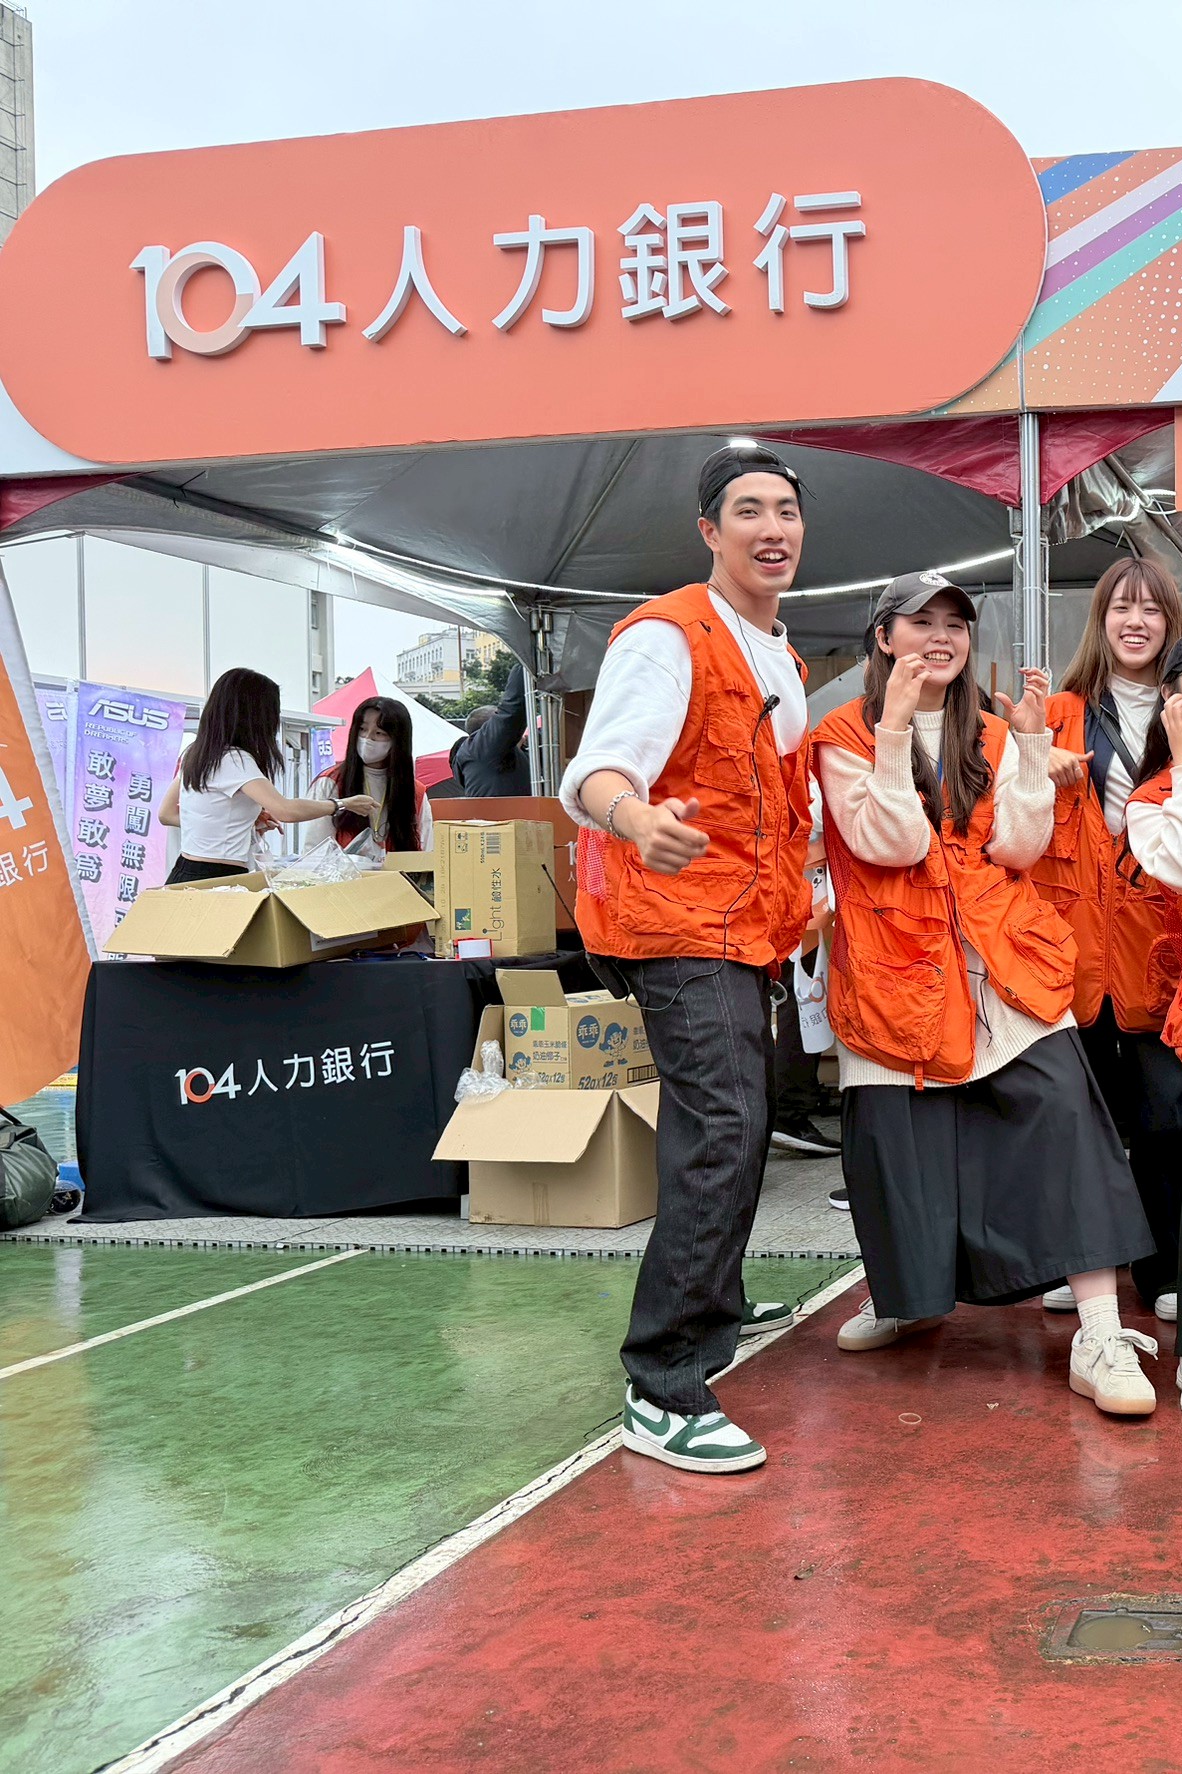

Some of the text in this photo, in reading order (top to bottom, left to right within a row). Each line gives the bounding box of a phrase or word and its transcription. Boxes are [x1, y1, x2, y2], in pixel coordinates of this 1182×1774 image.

[129, 190, 867, 360] 104人力銀行
[88, 699, 170, 731] ASUS
[578, 1022, 599, 1040] 乖乖
[175, 1041, 395, 1105] 104人力銀行
